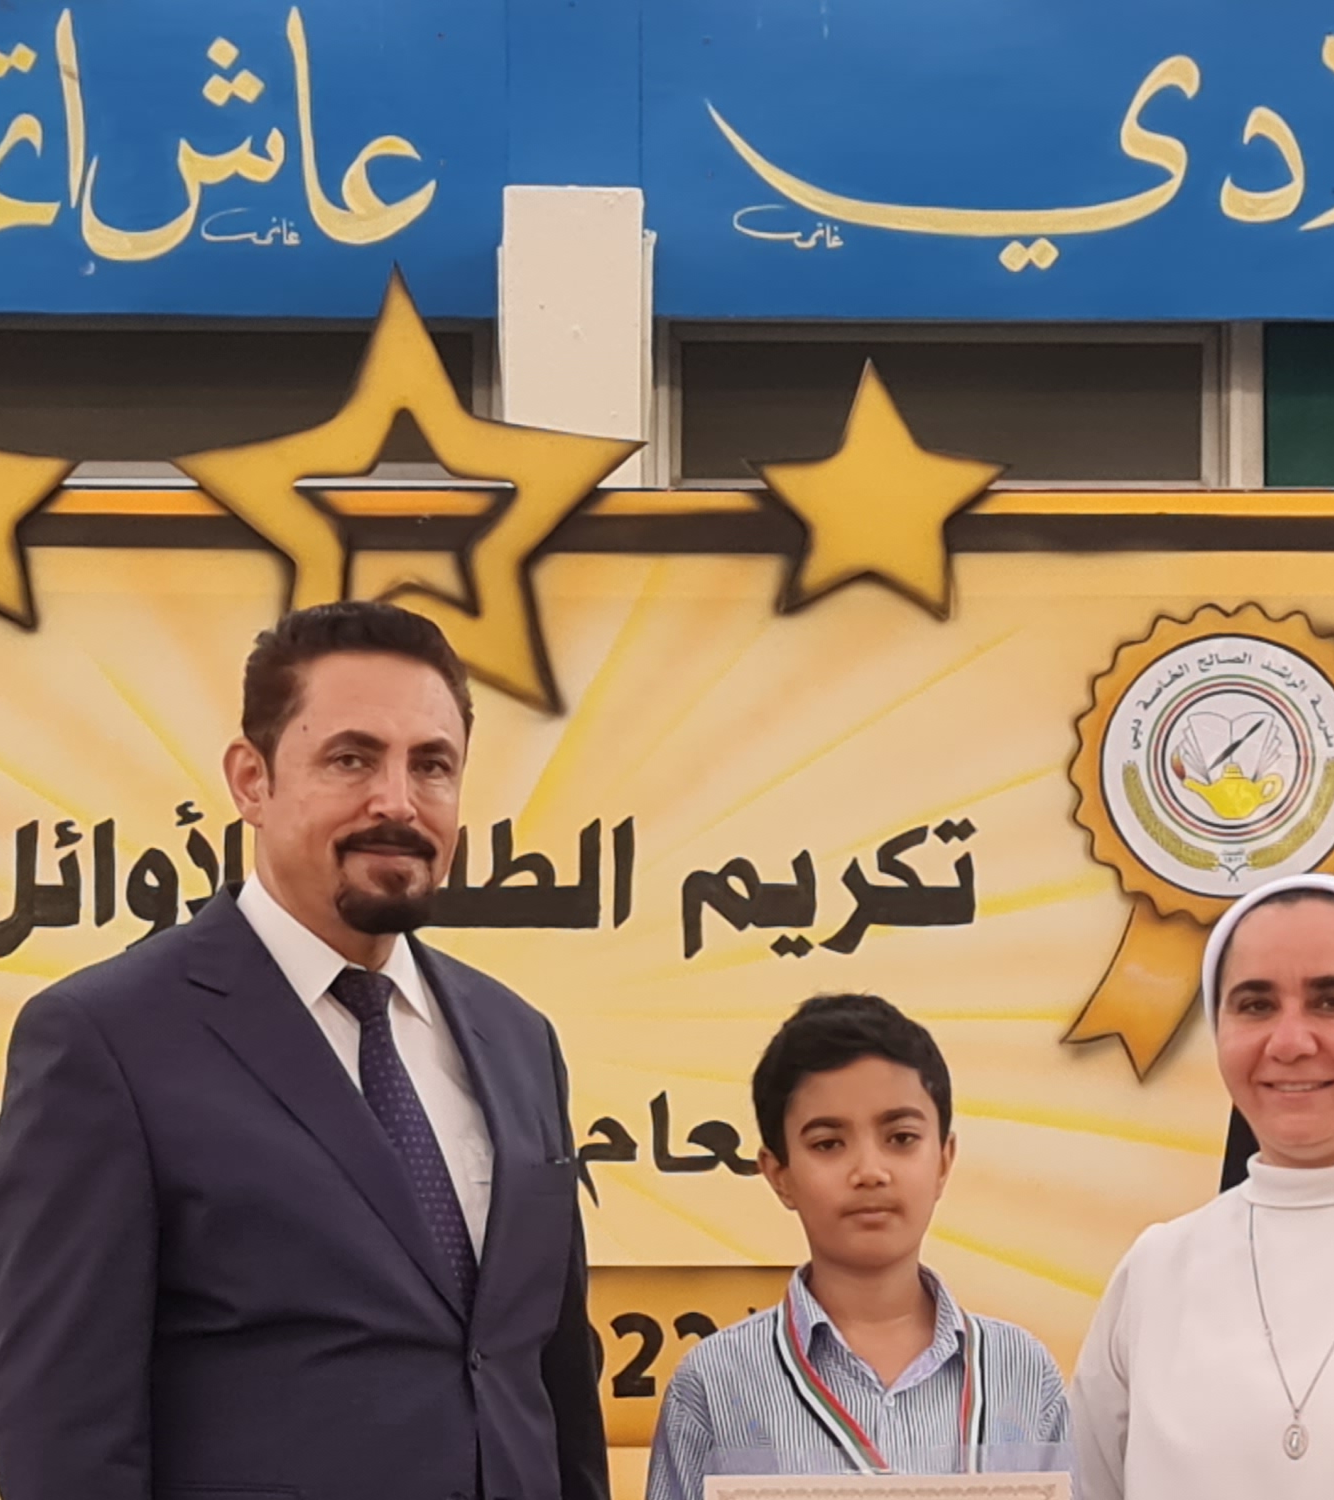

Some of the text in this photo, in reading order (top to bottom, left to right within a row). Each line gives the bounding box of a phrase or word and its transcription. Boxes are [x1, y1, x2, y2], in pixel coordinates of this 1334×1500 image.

[83, 10, 436, 261] عاش
[1135, 663, 1191, 711] الخاصة
[682, 817, 977, 959] تكريم
